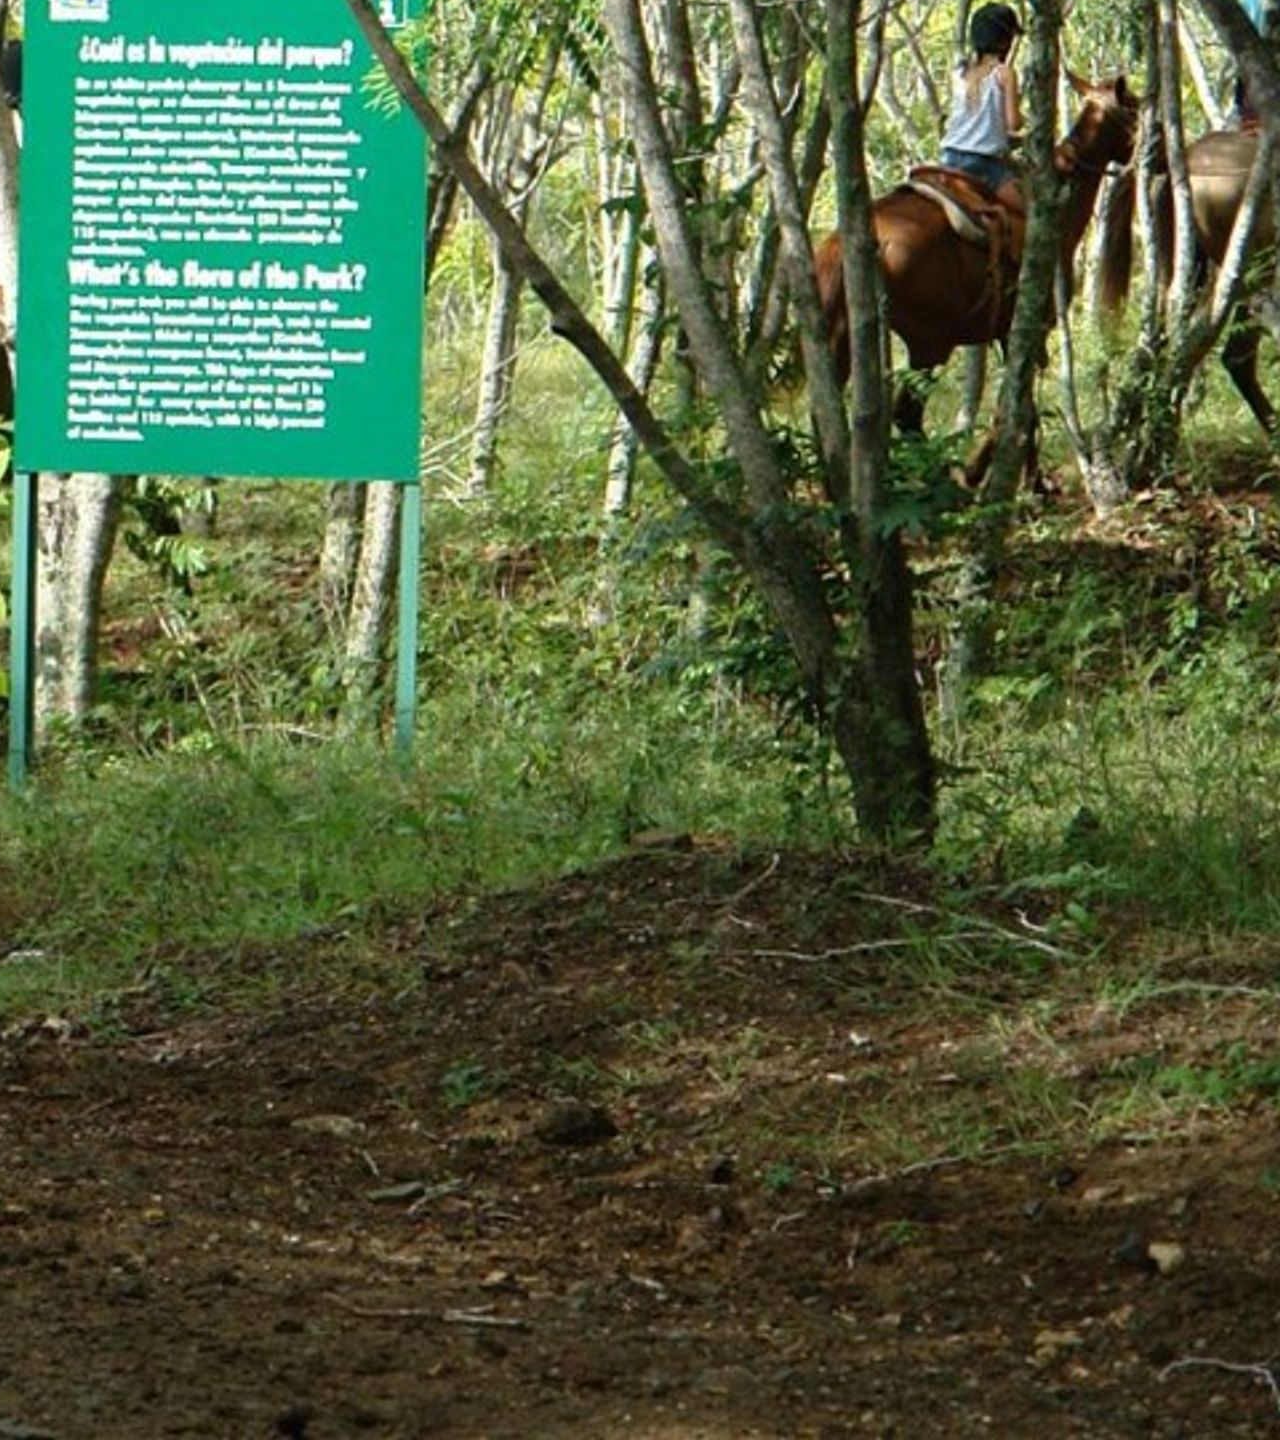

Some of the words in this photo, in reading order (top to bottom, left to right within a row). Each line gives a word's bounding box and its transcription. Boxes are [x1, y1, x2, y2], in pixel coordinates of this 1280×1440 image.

[126, 44, 146, 62] es
[148, 37, 166, 62] la
[168, 38, 254, 69] vegetación
[255, 39, 285, 64] del
[285, 40, 354, 69] parque?
[68, 259, 140, 285] What's
[144, 260, 179, 286] the
[238, 262, 261, 288] of
[264, 262, 299, 289] the
[304, 264, 366, 290] Park?
